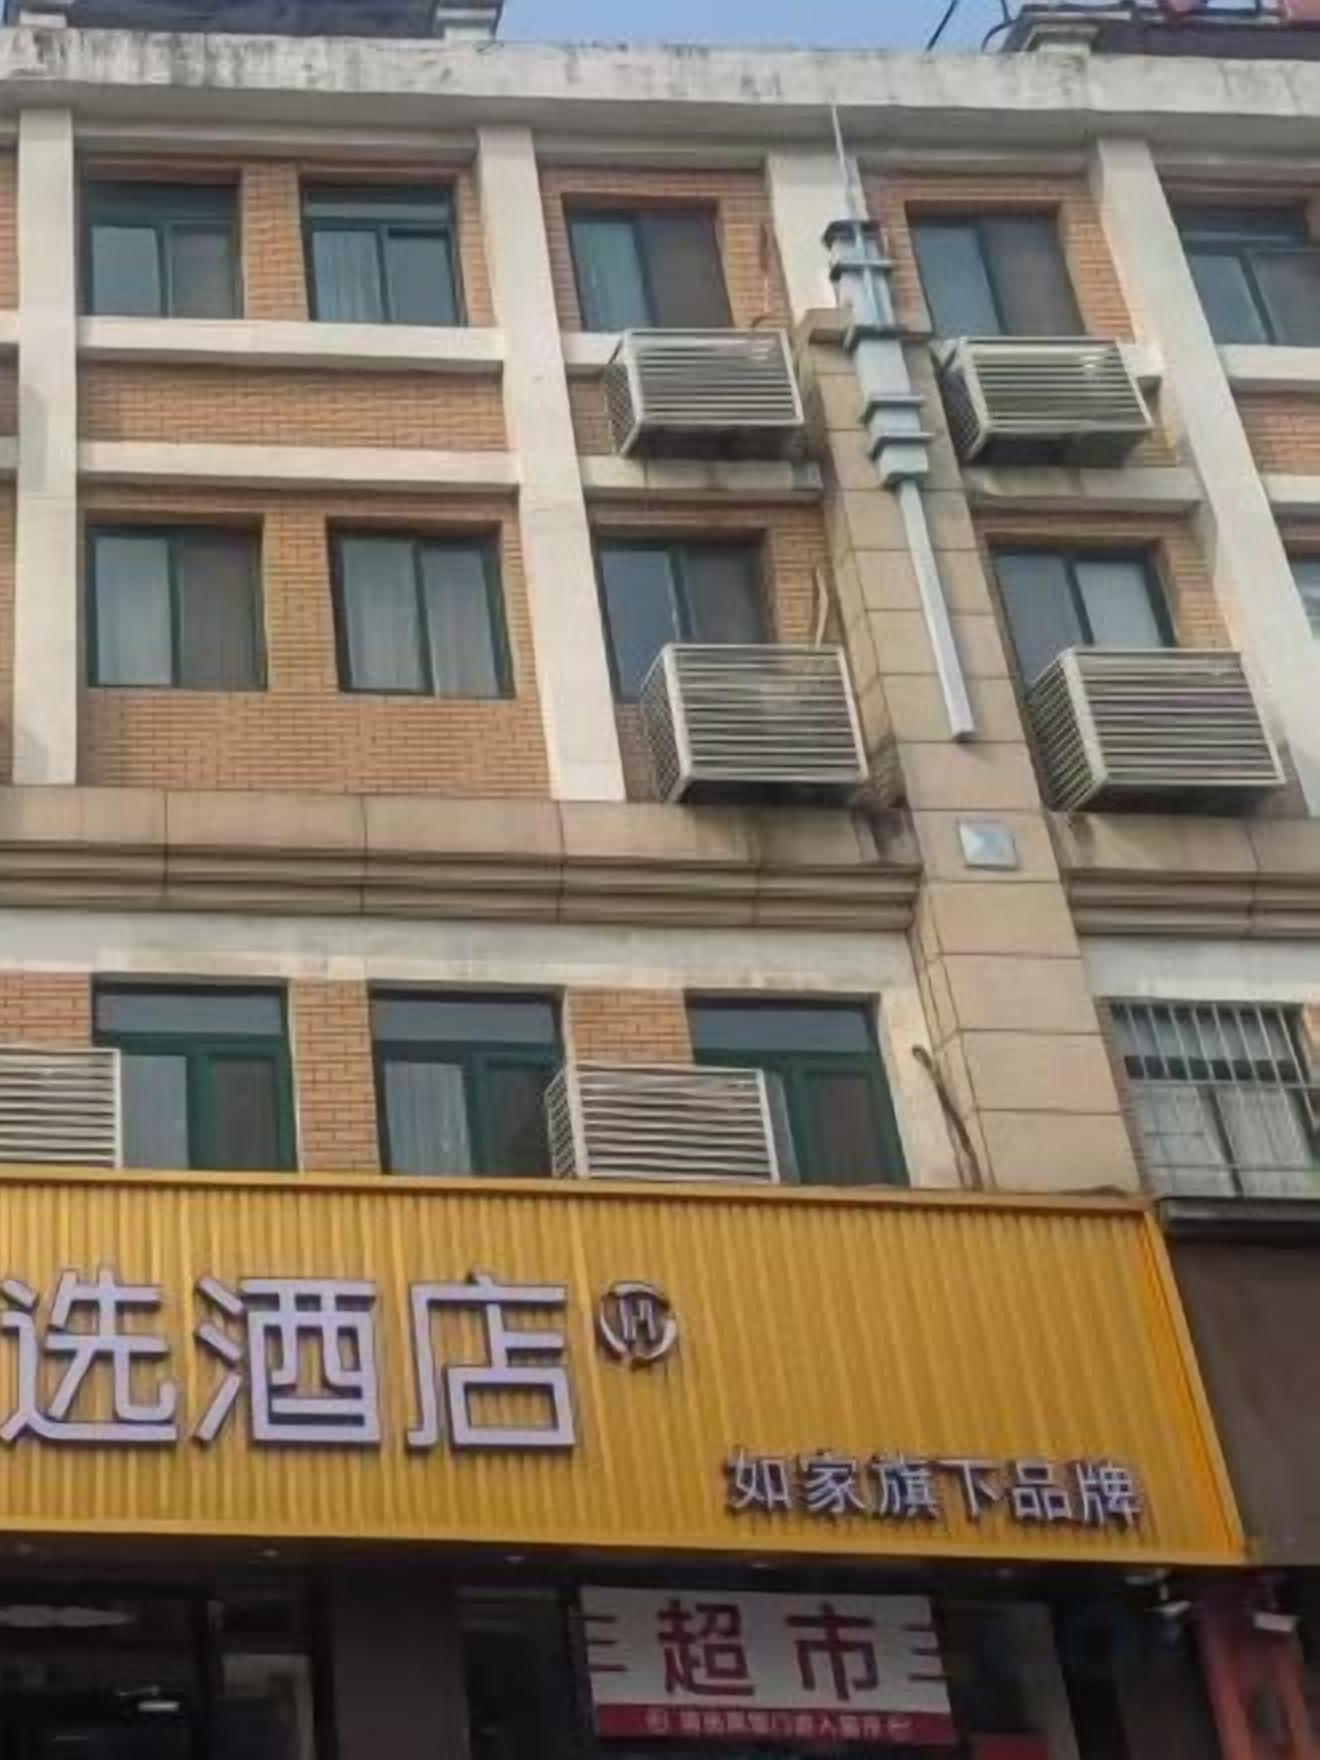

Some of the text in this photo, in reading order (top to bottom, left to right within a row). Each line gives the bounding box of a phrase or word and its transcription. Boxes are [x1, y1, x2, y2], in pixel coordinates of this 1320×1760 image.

[725, 1446, 1144, 1526] 如家旗下品牌
[656, 1600, 879, 1701] 超市
